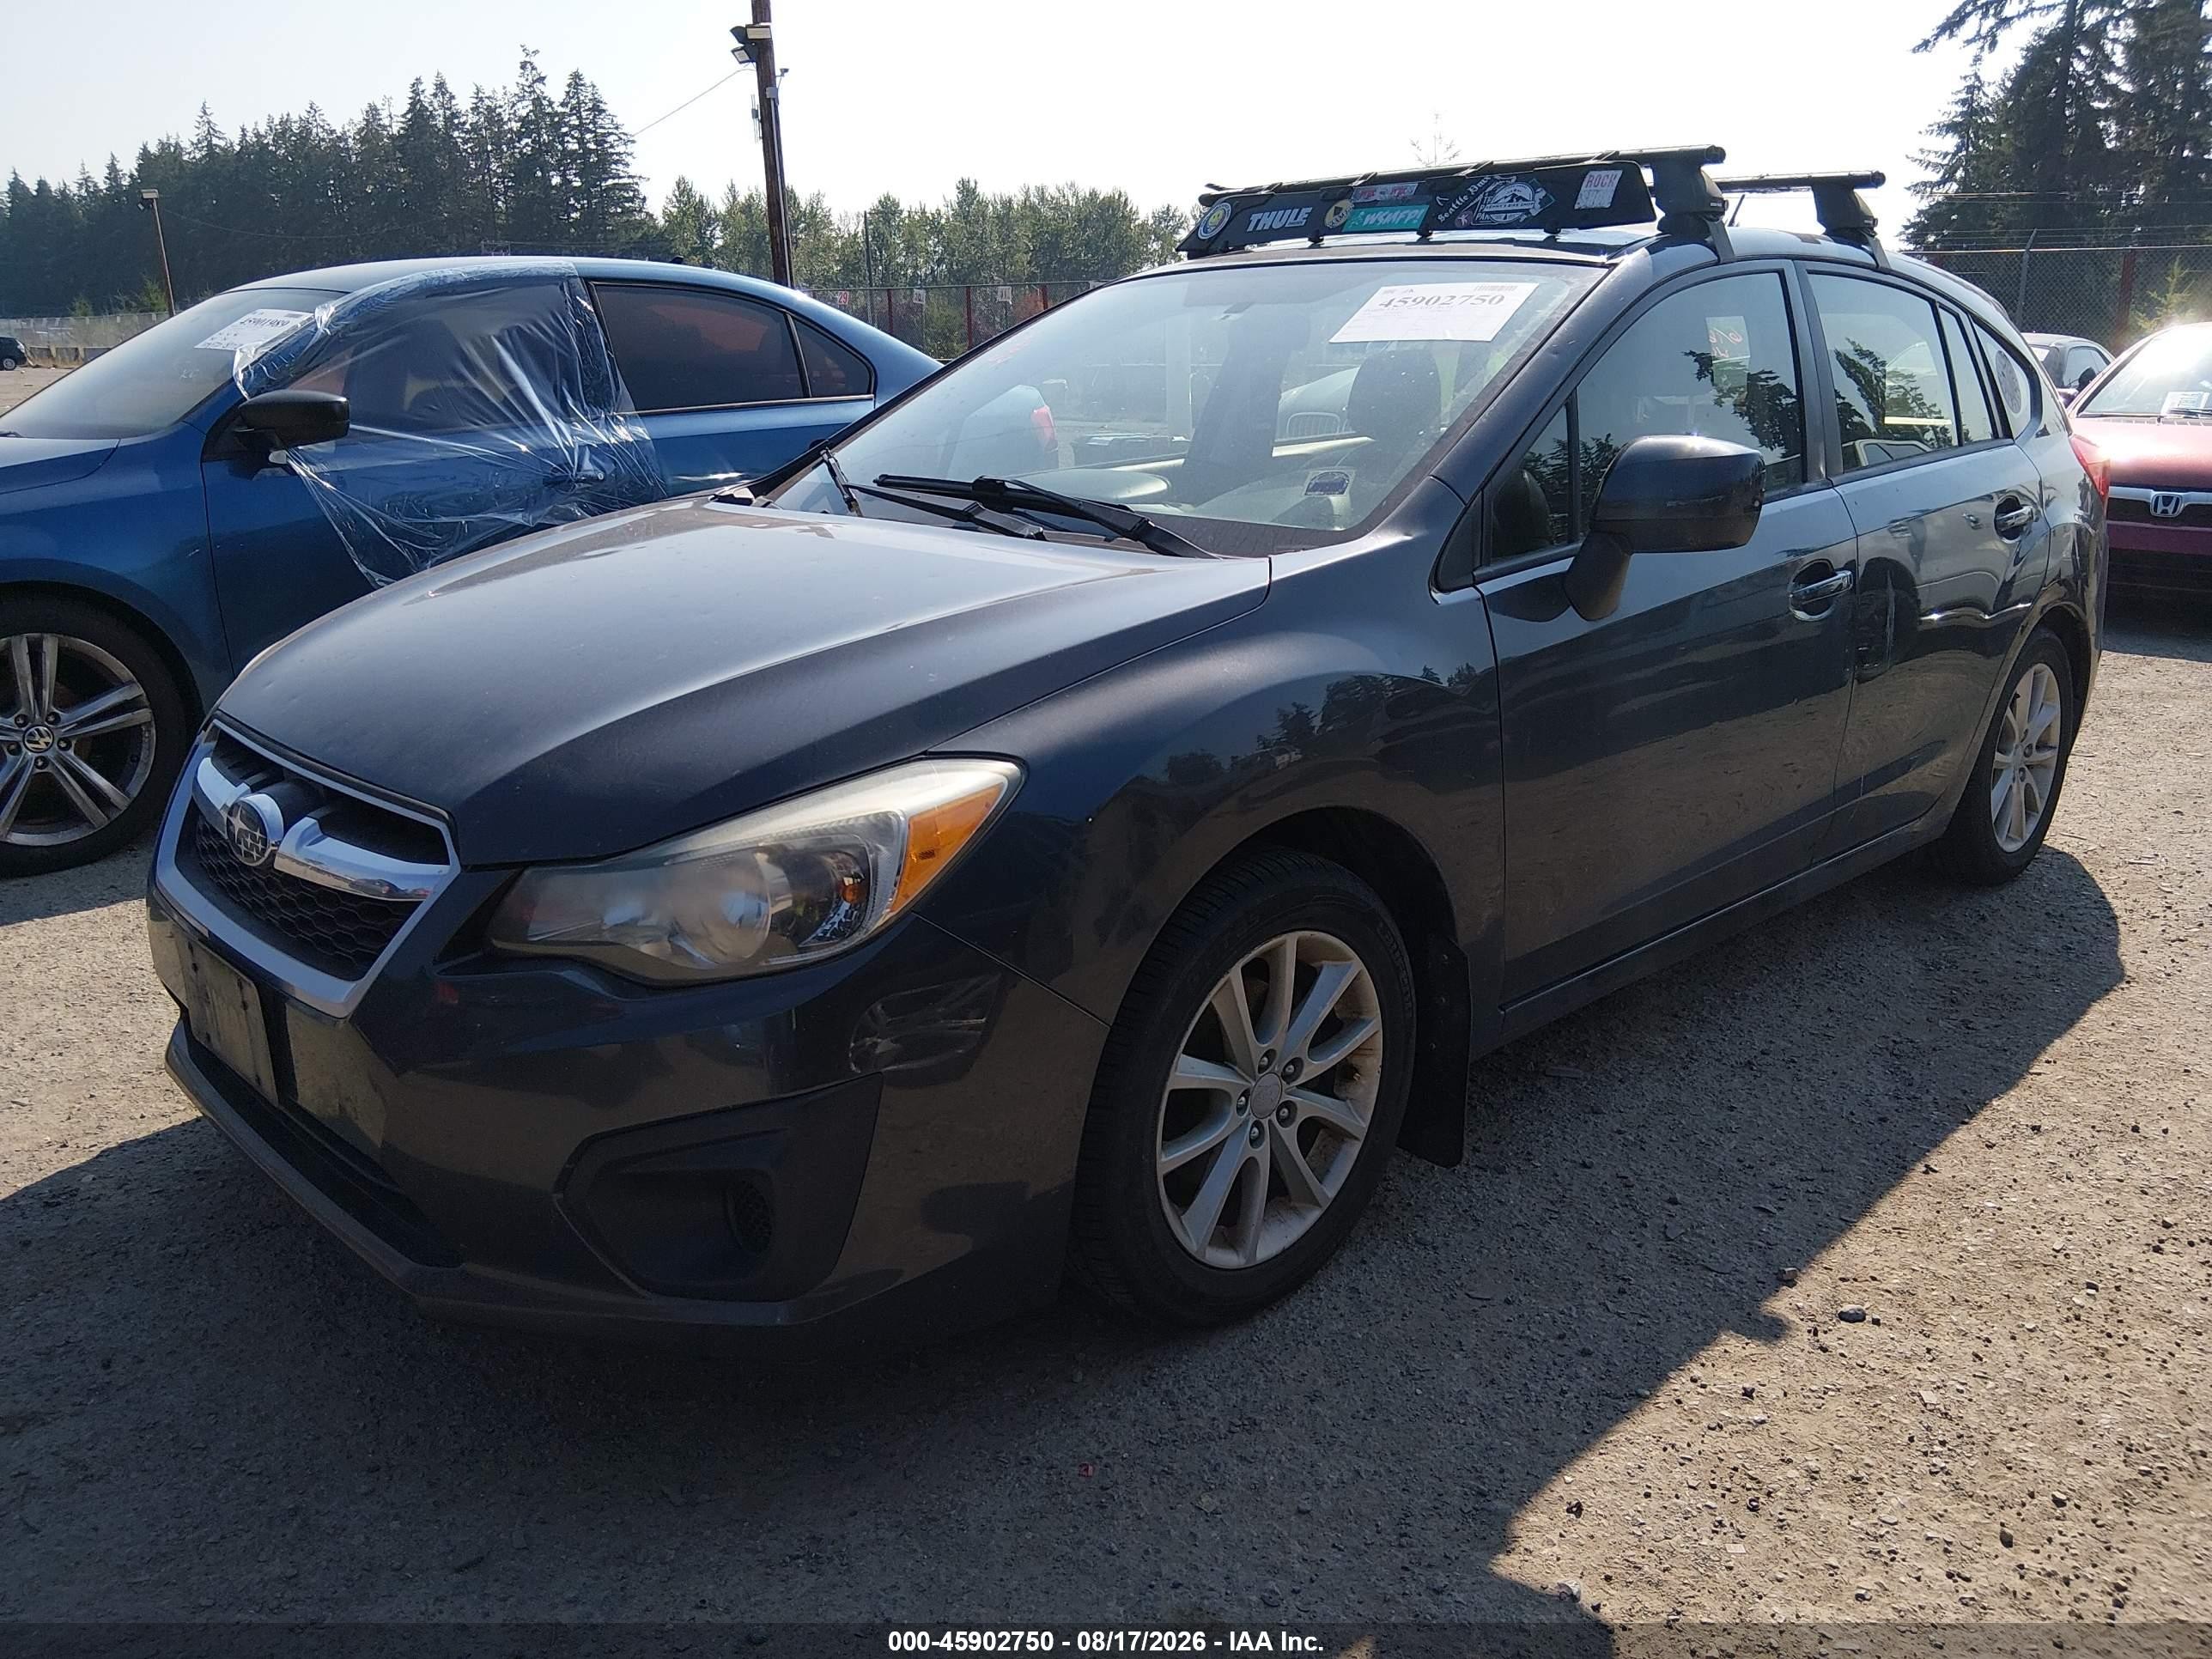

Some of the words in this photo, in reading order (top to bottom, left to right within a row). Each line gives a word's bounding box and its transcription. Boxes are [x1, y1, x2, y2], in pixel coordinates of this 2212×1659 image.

[1585, 173, 1619, 188] ROCK
[1437, 195, 1469, 222] Seattle
[1247, 207, 1313, 233] THULE
[838, 292, 848, 304] 29
[1379, 295, 1505, 308] 45902750
